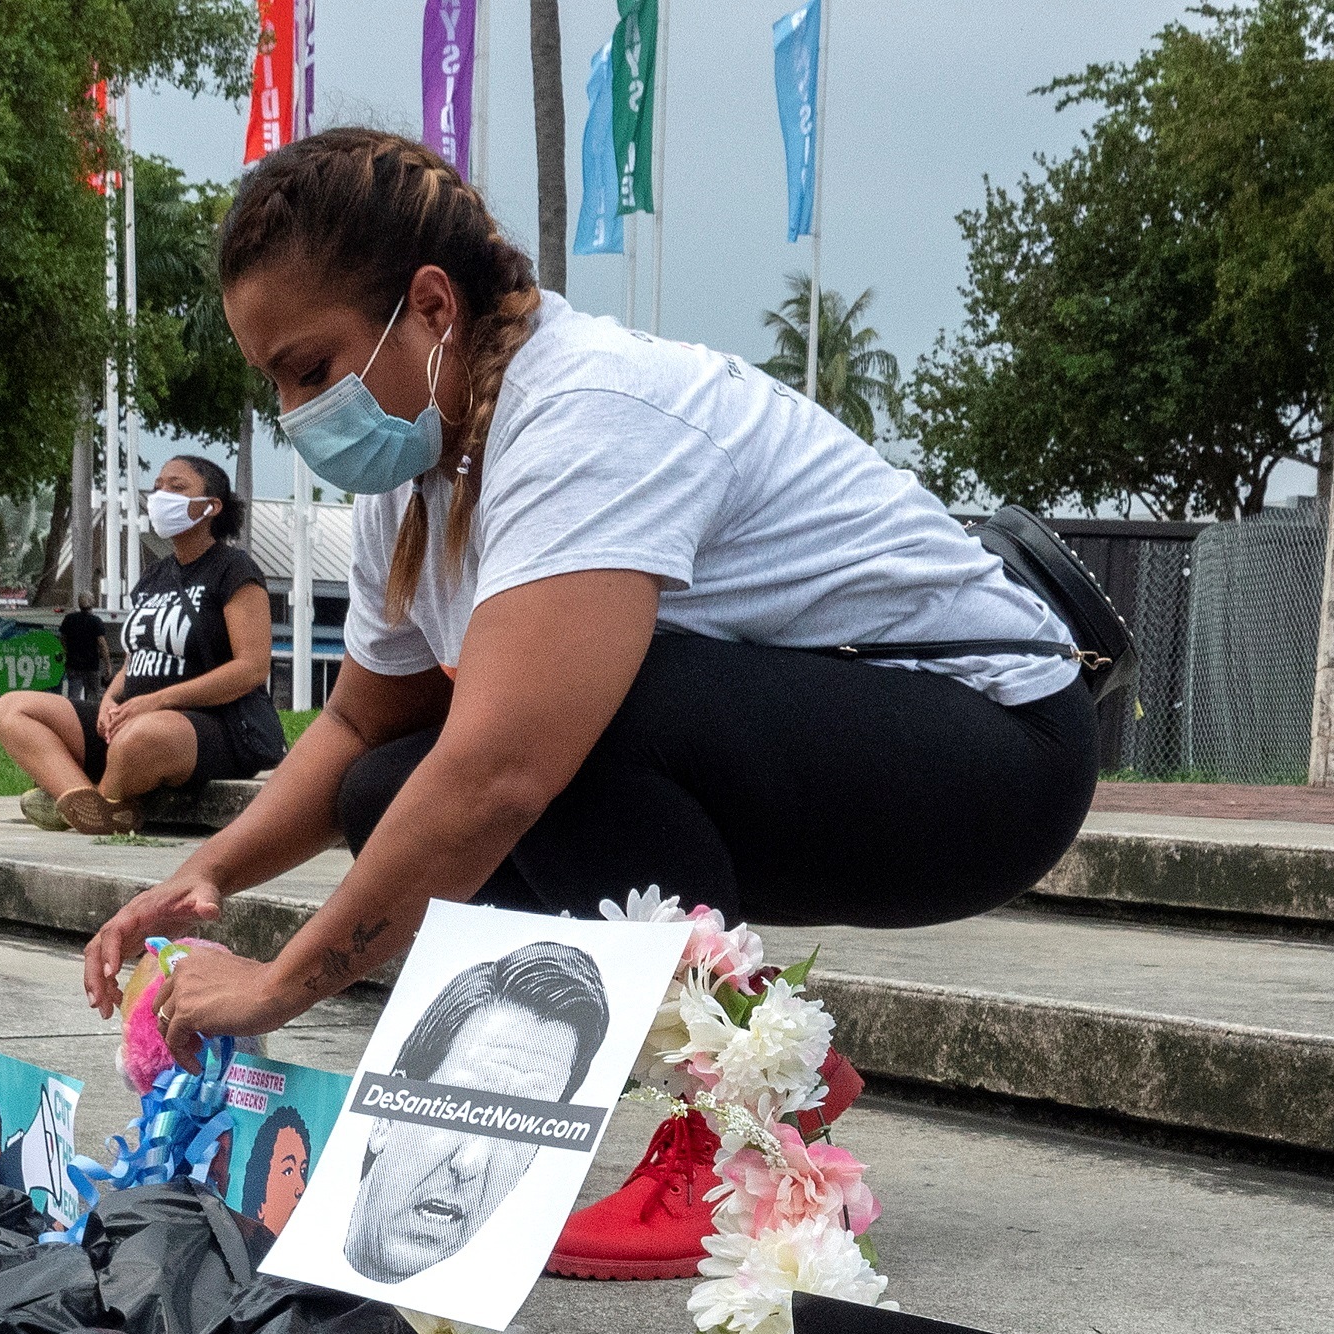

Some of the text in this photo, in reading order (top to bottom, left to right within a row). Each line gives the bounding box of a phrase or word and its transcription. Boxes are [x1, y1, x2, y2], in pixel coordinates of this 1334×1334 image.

[121, 604, 194, 659] EW
[247, 1069, 284, 1092] DESASTRE
[235, 1089, 267, 1112] CHECKS!
[362, 1083, 591, 1142] DeSantisActNow.com
